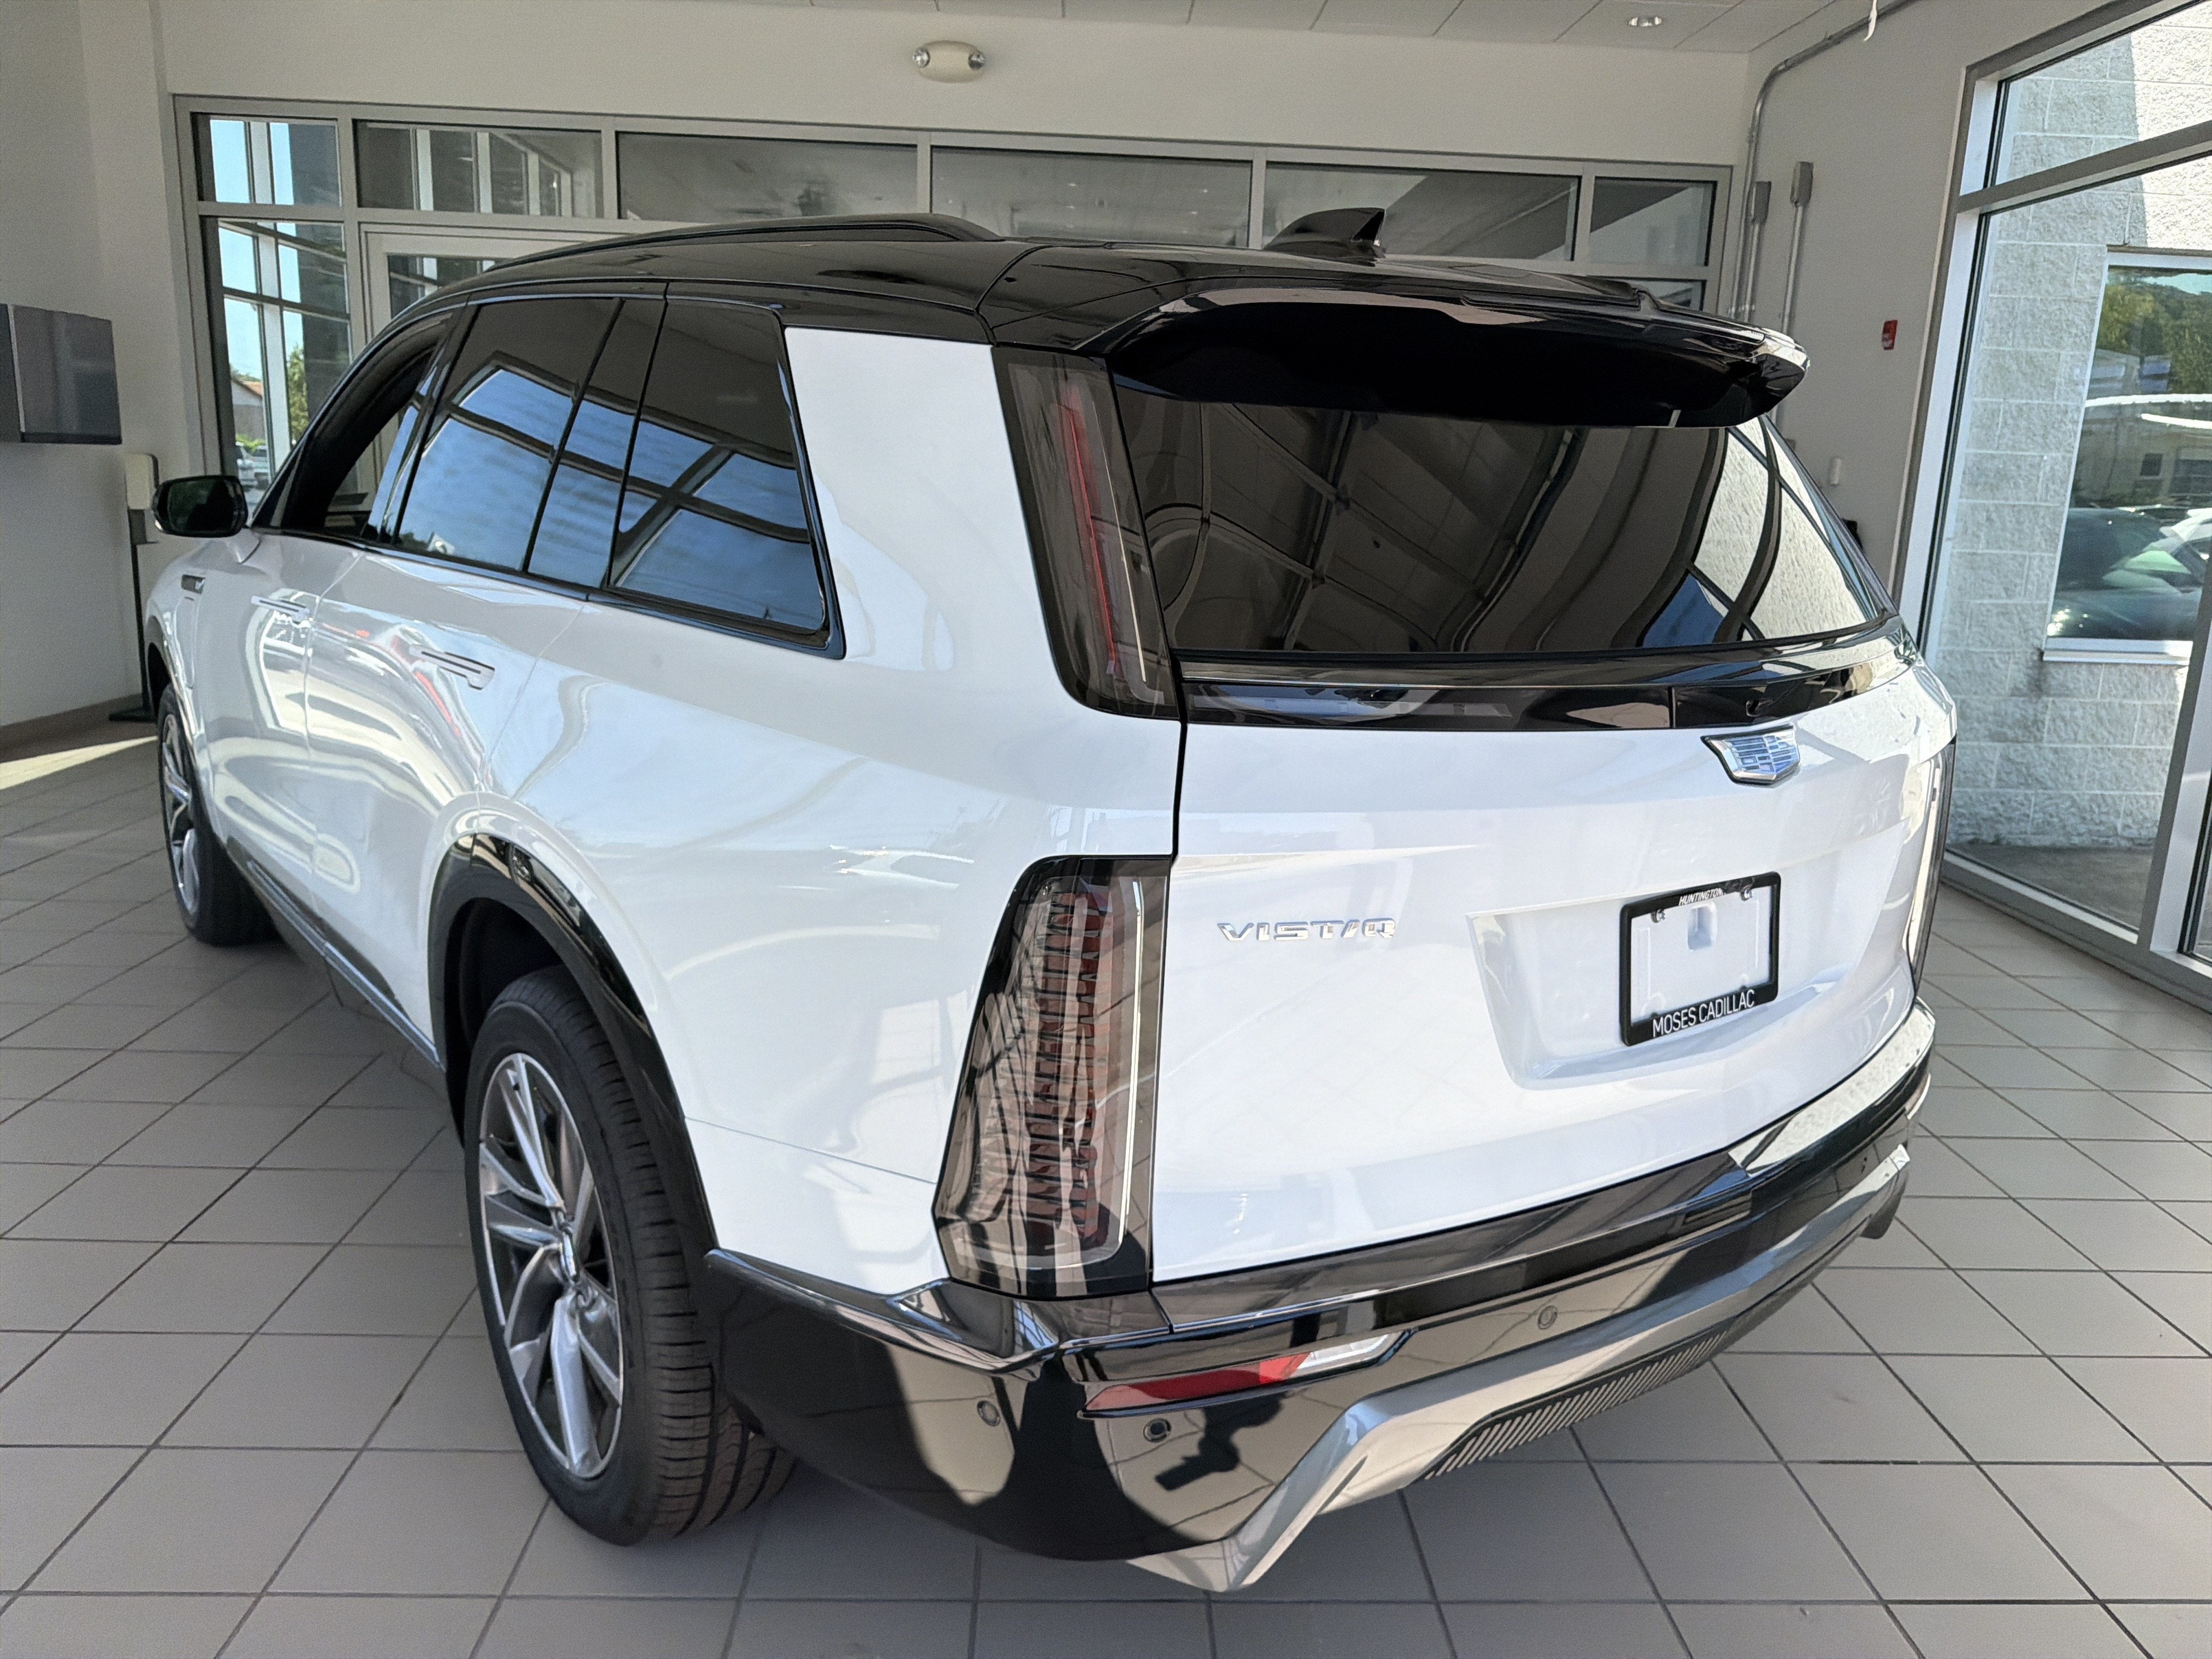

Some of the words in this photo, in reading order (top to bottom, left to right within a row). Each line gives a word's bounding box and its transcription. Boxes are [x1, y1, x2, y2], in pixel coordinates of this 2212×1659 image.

[1217, 917, 1396, 941] VISTIQ
[1652, 1007, 1696, 1037] MOSES
[1699, 989, 1755, 1022] CADILLAC
